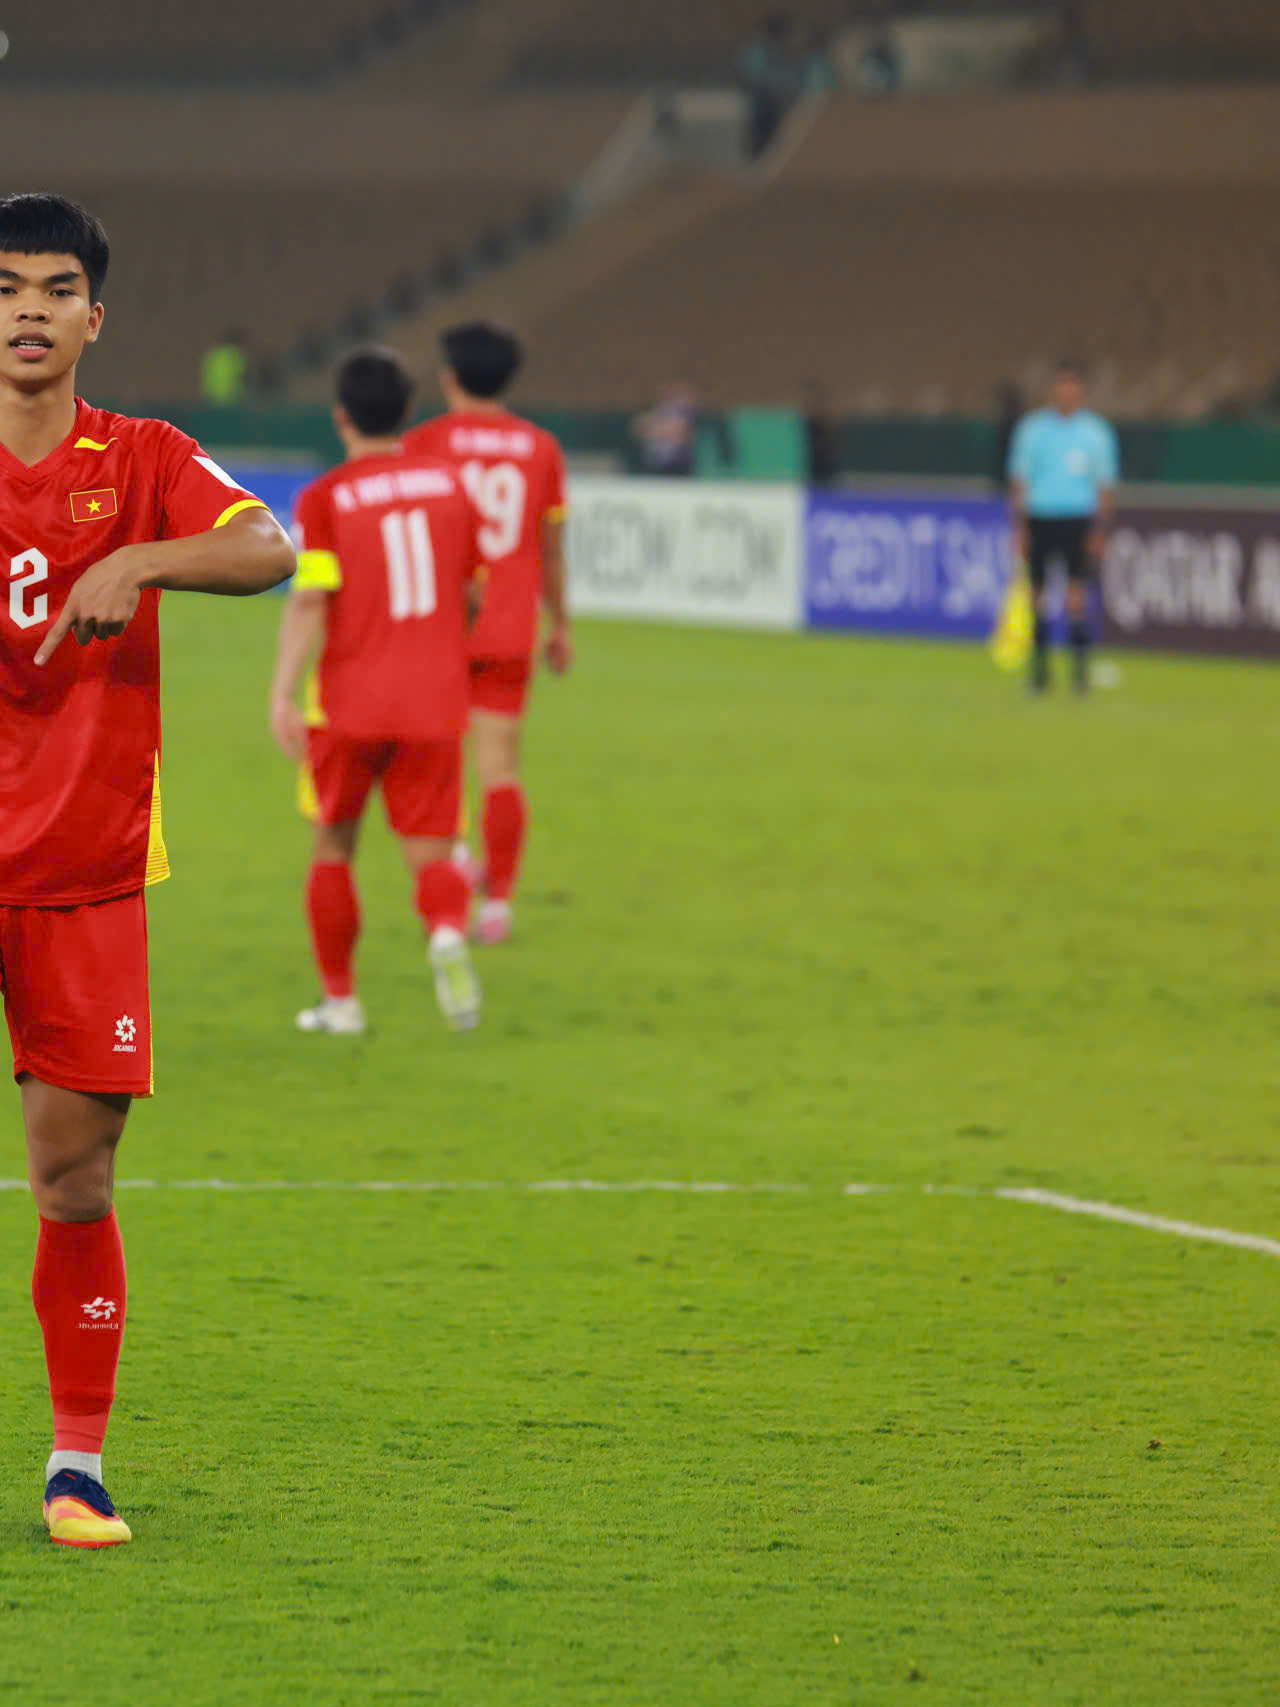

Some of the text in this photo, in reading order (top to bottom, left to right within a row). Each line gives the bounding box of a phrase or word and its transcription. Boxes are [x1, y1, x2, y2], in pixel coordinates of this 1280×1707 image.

[9, 548, 48, 629] 2
[381, 508, 437, 621] 11
[1106, 531, 1239, 627] QATAR
